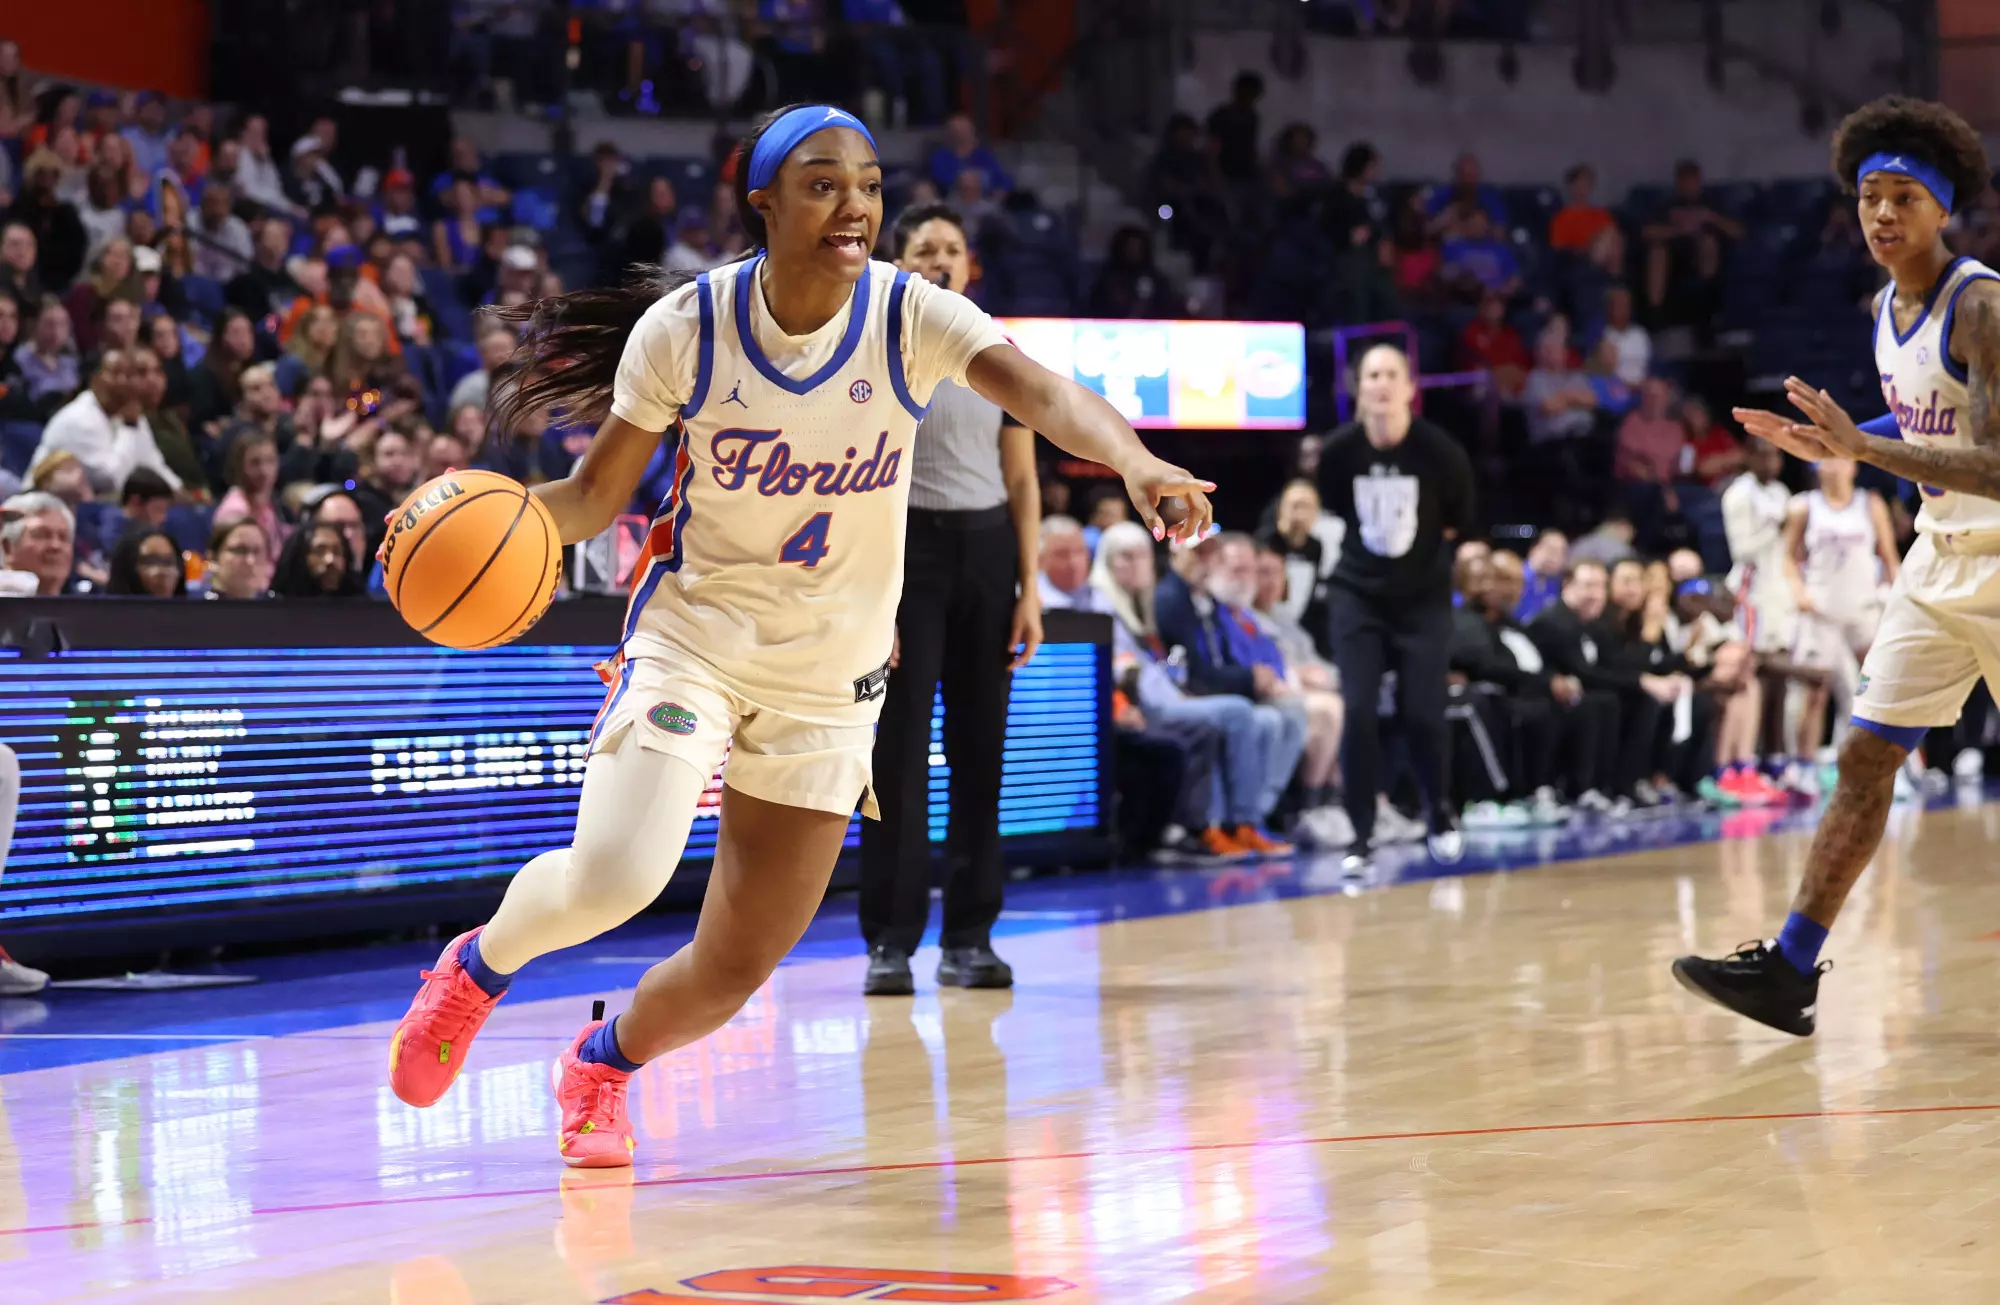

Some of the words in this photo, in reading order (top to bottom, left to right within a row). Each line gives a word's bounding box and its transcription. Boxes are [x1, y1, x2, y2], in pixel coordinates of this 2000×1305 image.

[850, 381, 871, 402] SEC
[711, 427, 903, 497] Florida
[383, 481, 466, 575] Wilson
[778, 511, 833, 568] 4
